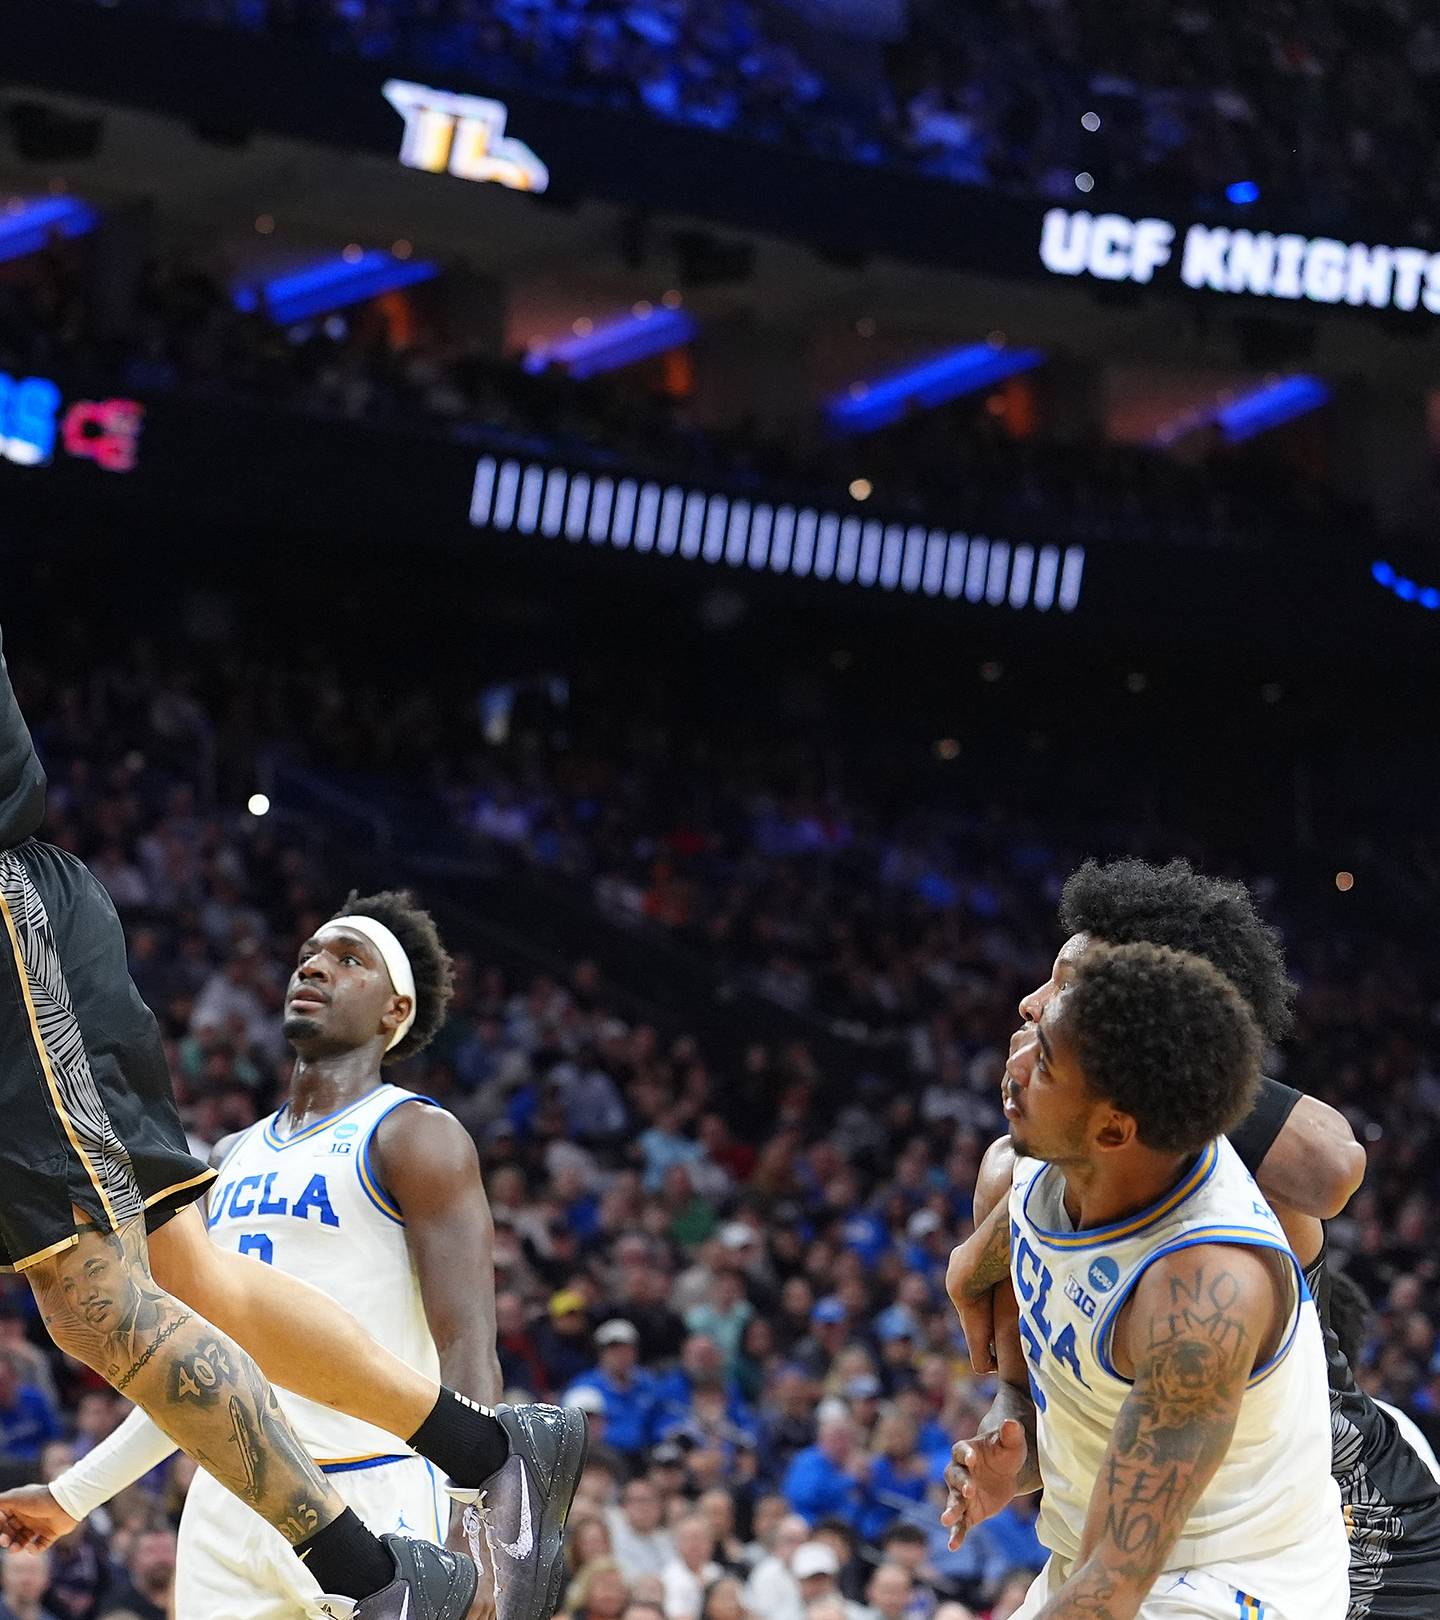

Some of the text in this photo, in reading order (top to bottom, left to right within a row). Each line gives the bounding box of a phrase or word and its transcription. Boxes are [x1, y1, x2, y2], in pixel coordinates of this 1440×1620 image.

[1039, 208, 1176, 284] UCF
[208, 1172, 340, 1230] UCLA
[1170, 1269, 1240, 1311] NO
[179, 1343, 230, 1397] 407
